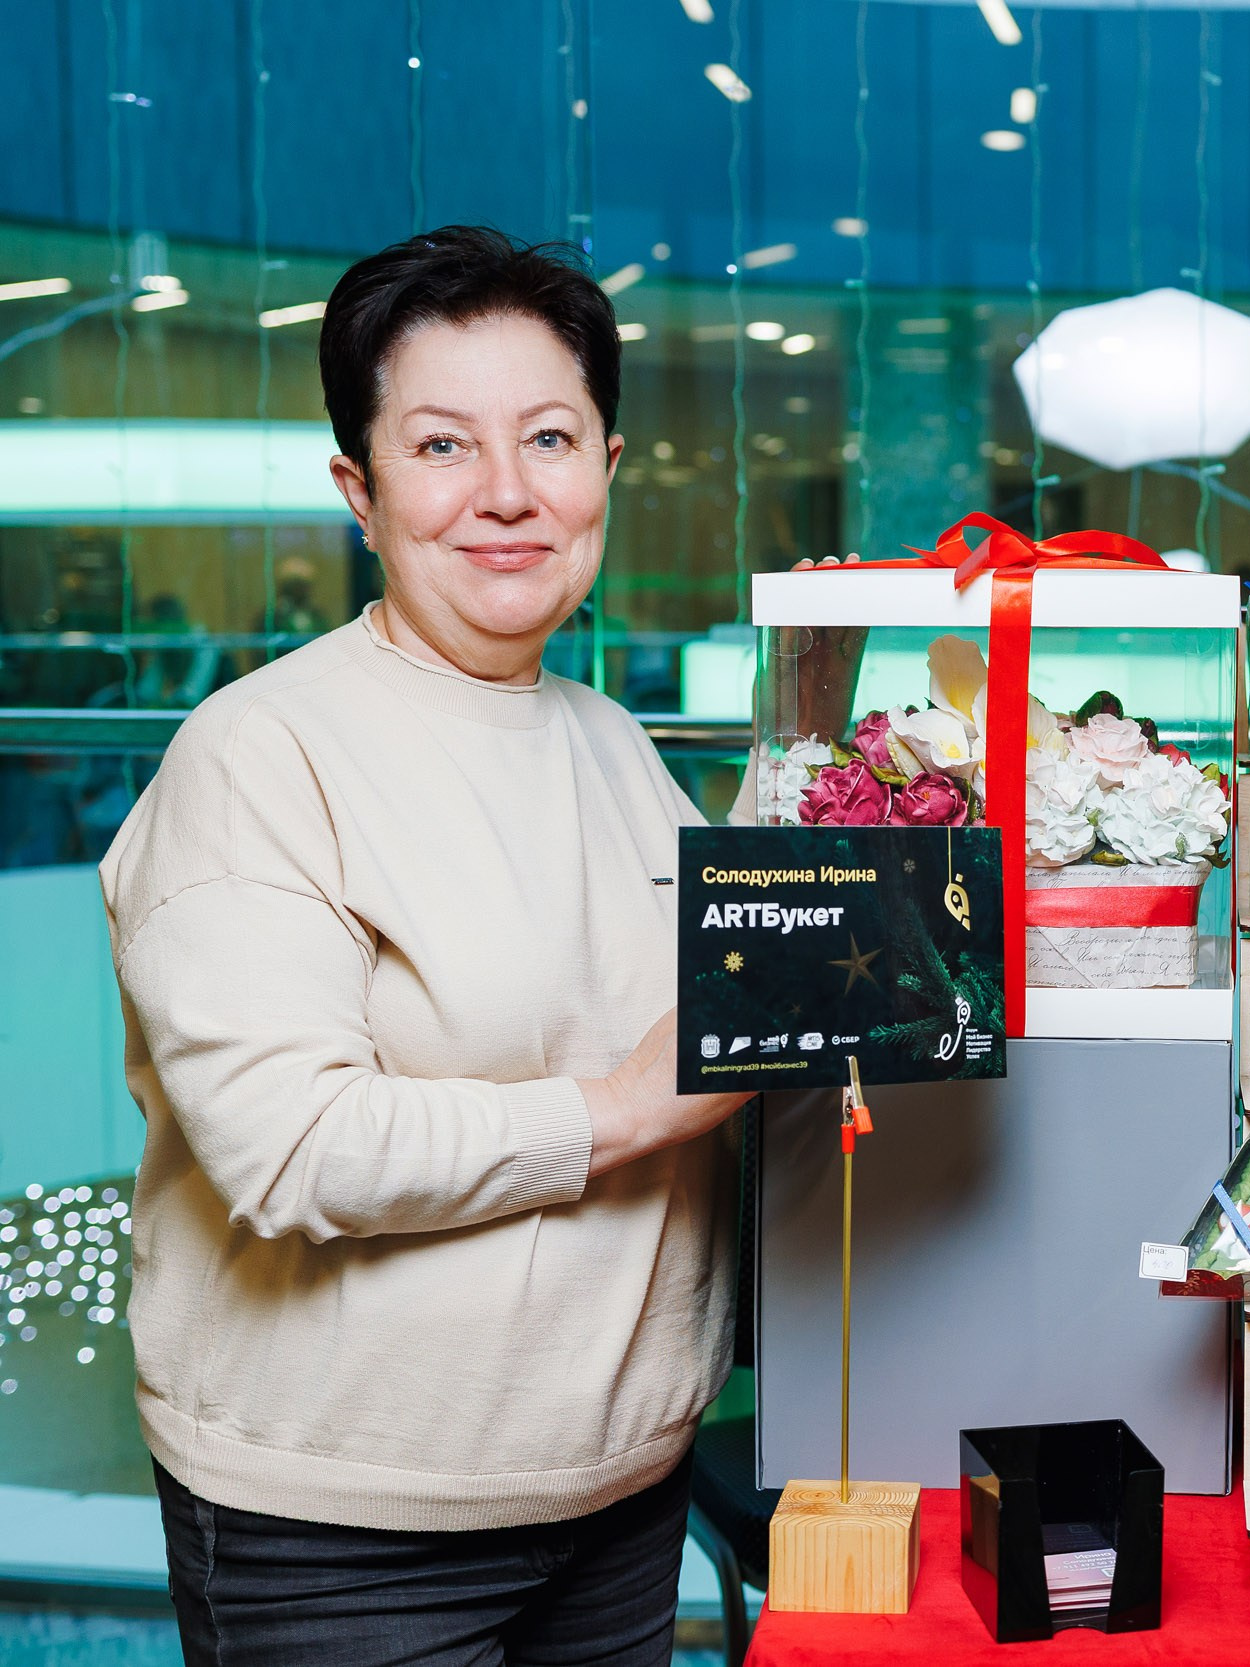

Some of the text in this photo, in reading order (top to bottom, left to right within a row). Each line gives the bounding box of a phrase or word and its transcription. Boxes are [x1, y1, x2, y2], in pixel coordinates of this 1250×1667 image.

[702, 866, 877, 888] Солодухина Ирина
[701, 903, 845, 935] ARTБукет
